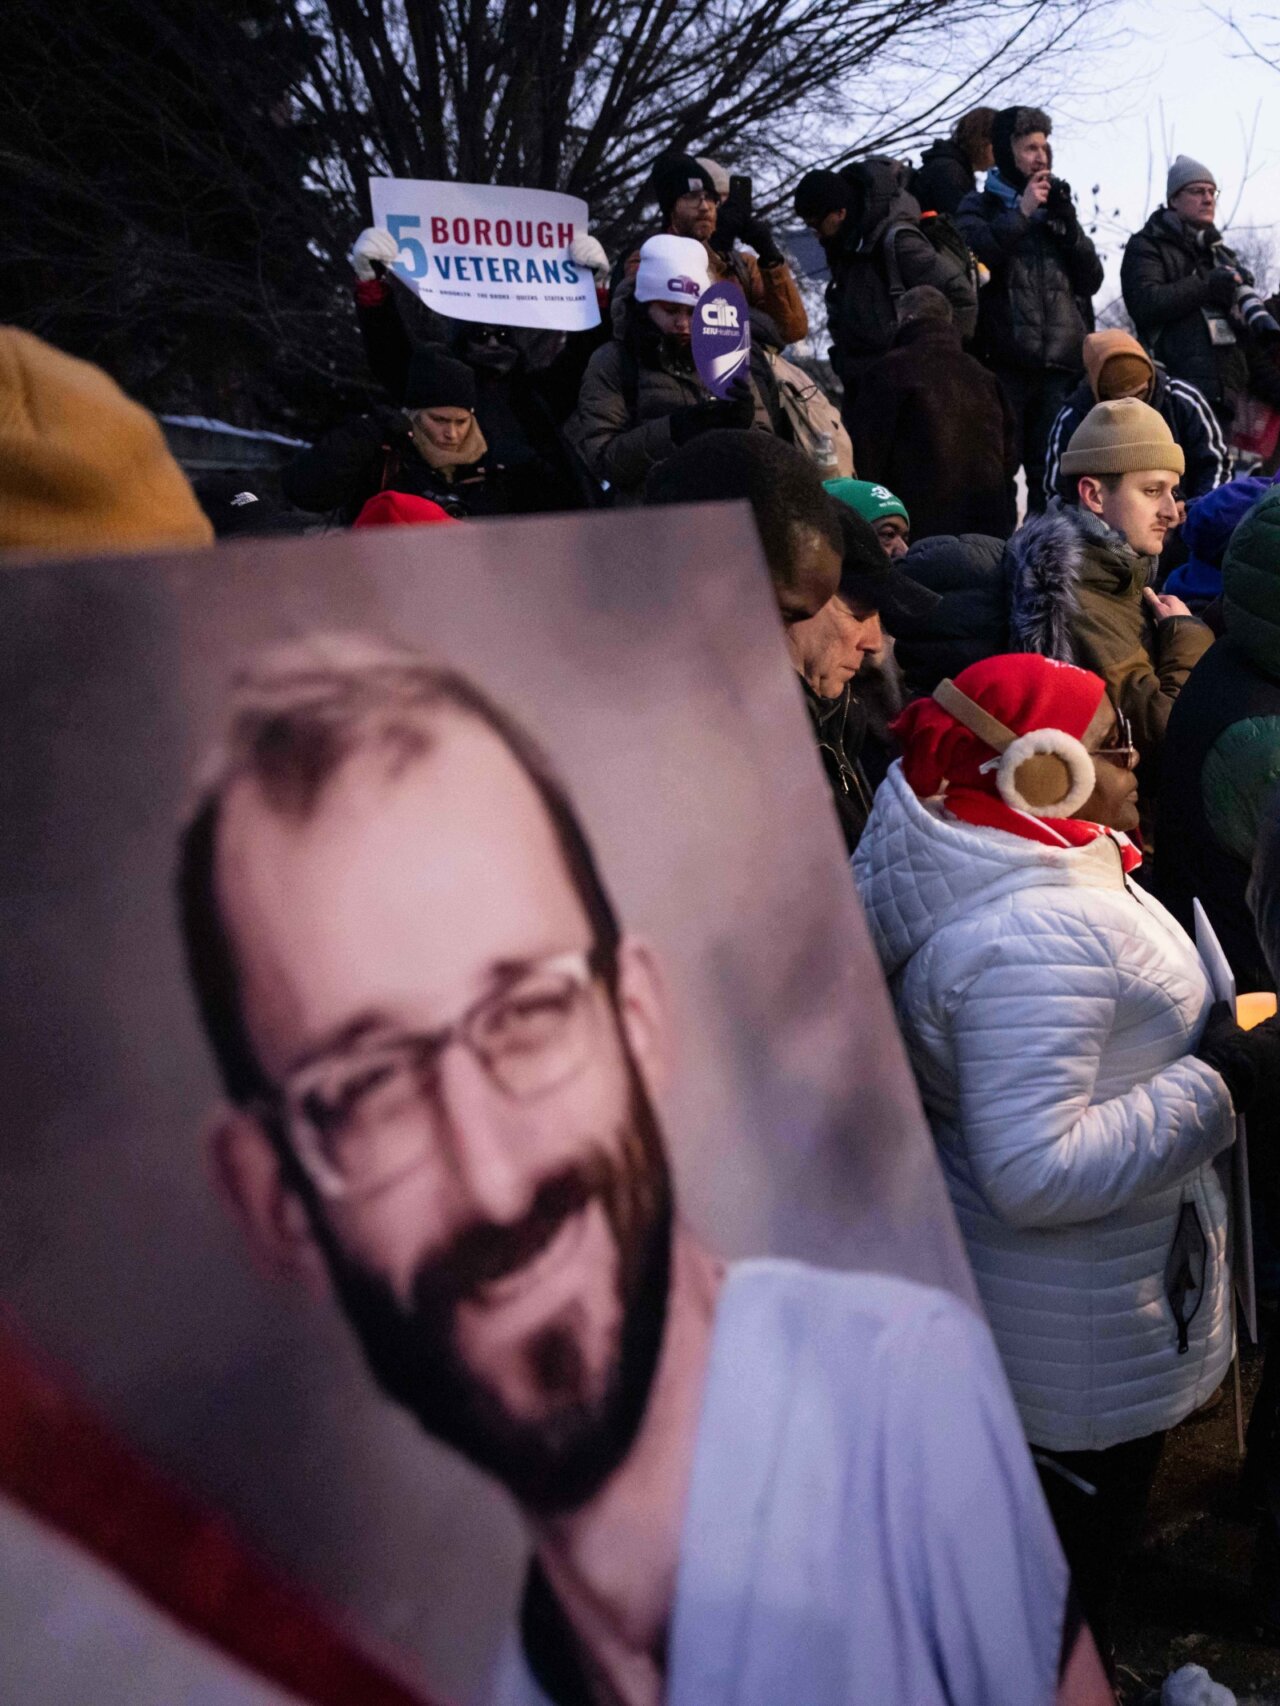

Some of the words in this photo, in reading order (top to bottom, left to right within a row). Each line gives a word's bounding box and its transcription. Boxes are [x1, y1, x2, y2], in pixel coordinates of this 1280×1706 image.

[386, 214, 429, 279] 5
[430, 216, 574, 249] BOROUGH
[433, 255, 580, 284] VETERANS
